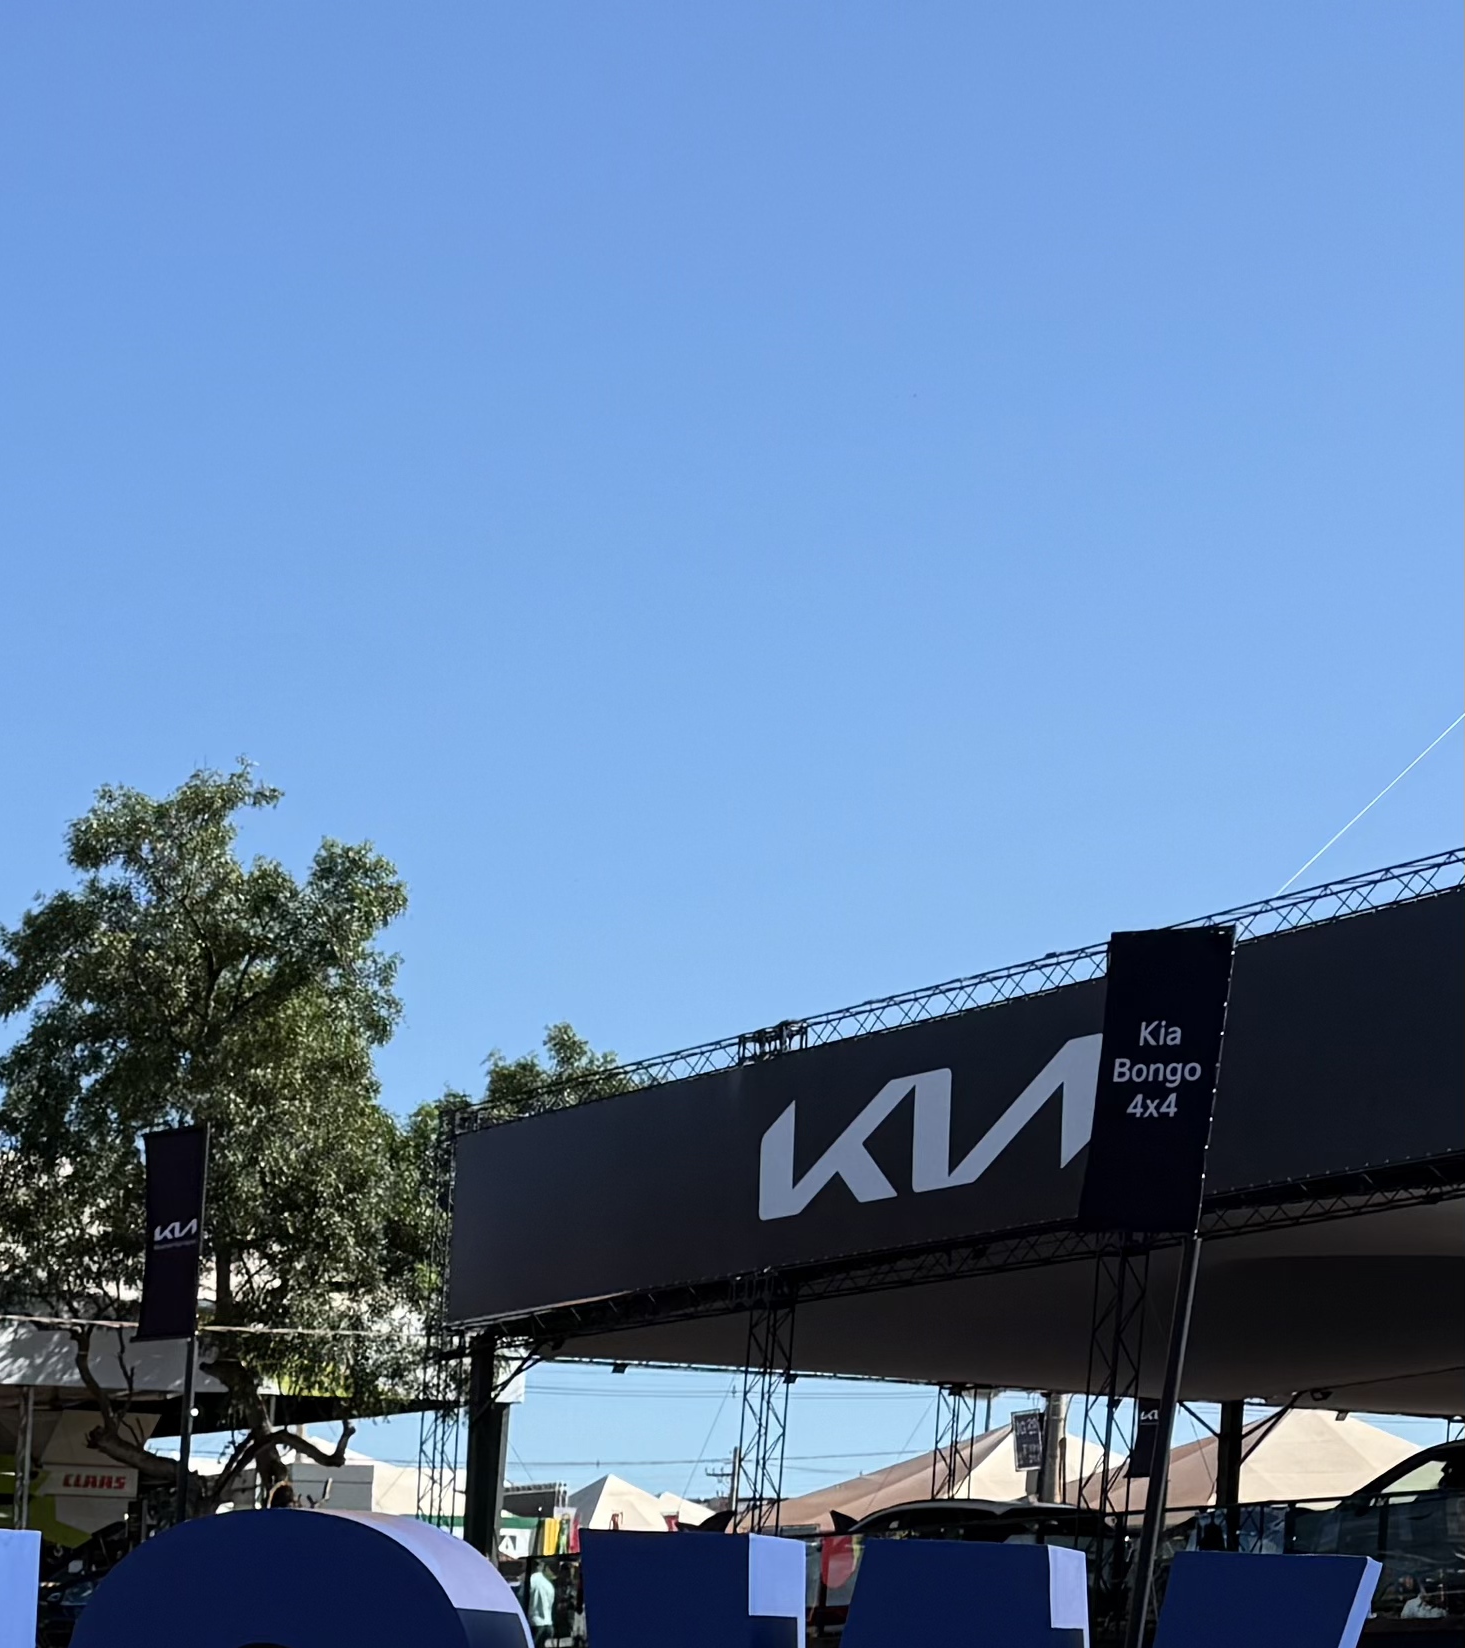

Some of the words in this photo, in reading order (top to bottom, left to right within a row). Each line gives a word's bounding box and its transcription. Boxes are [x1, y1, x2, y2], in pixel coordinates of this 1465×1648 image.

[1139, 1020, 1181, 1046] Kia
[1113, 1058, 1202, 1088] Bongo
[1126, 1092, 1178, 1118] 4x4
[62, 1473, 127, 1490] CLAAS
